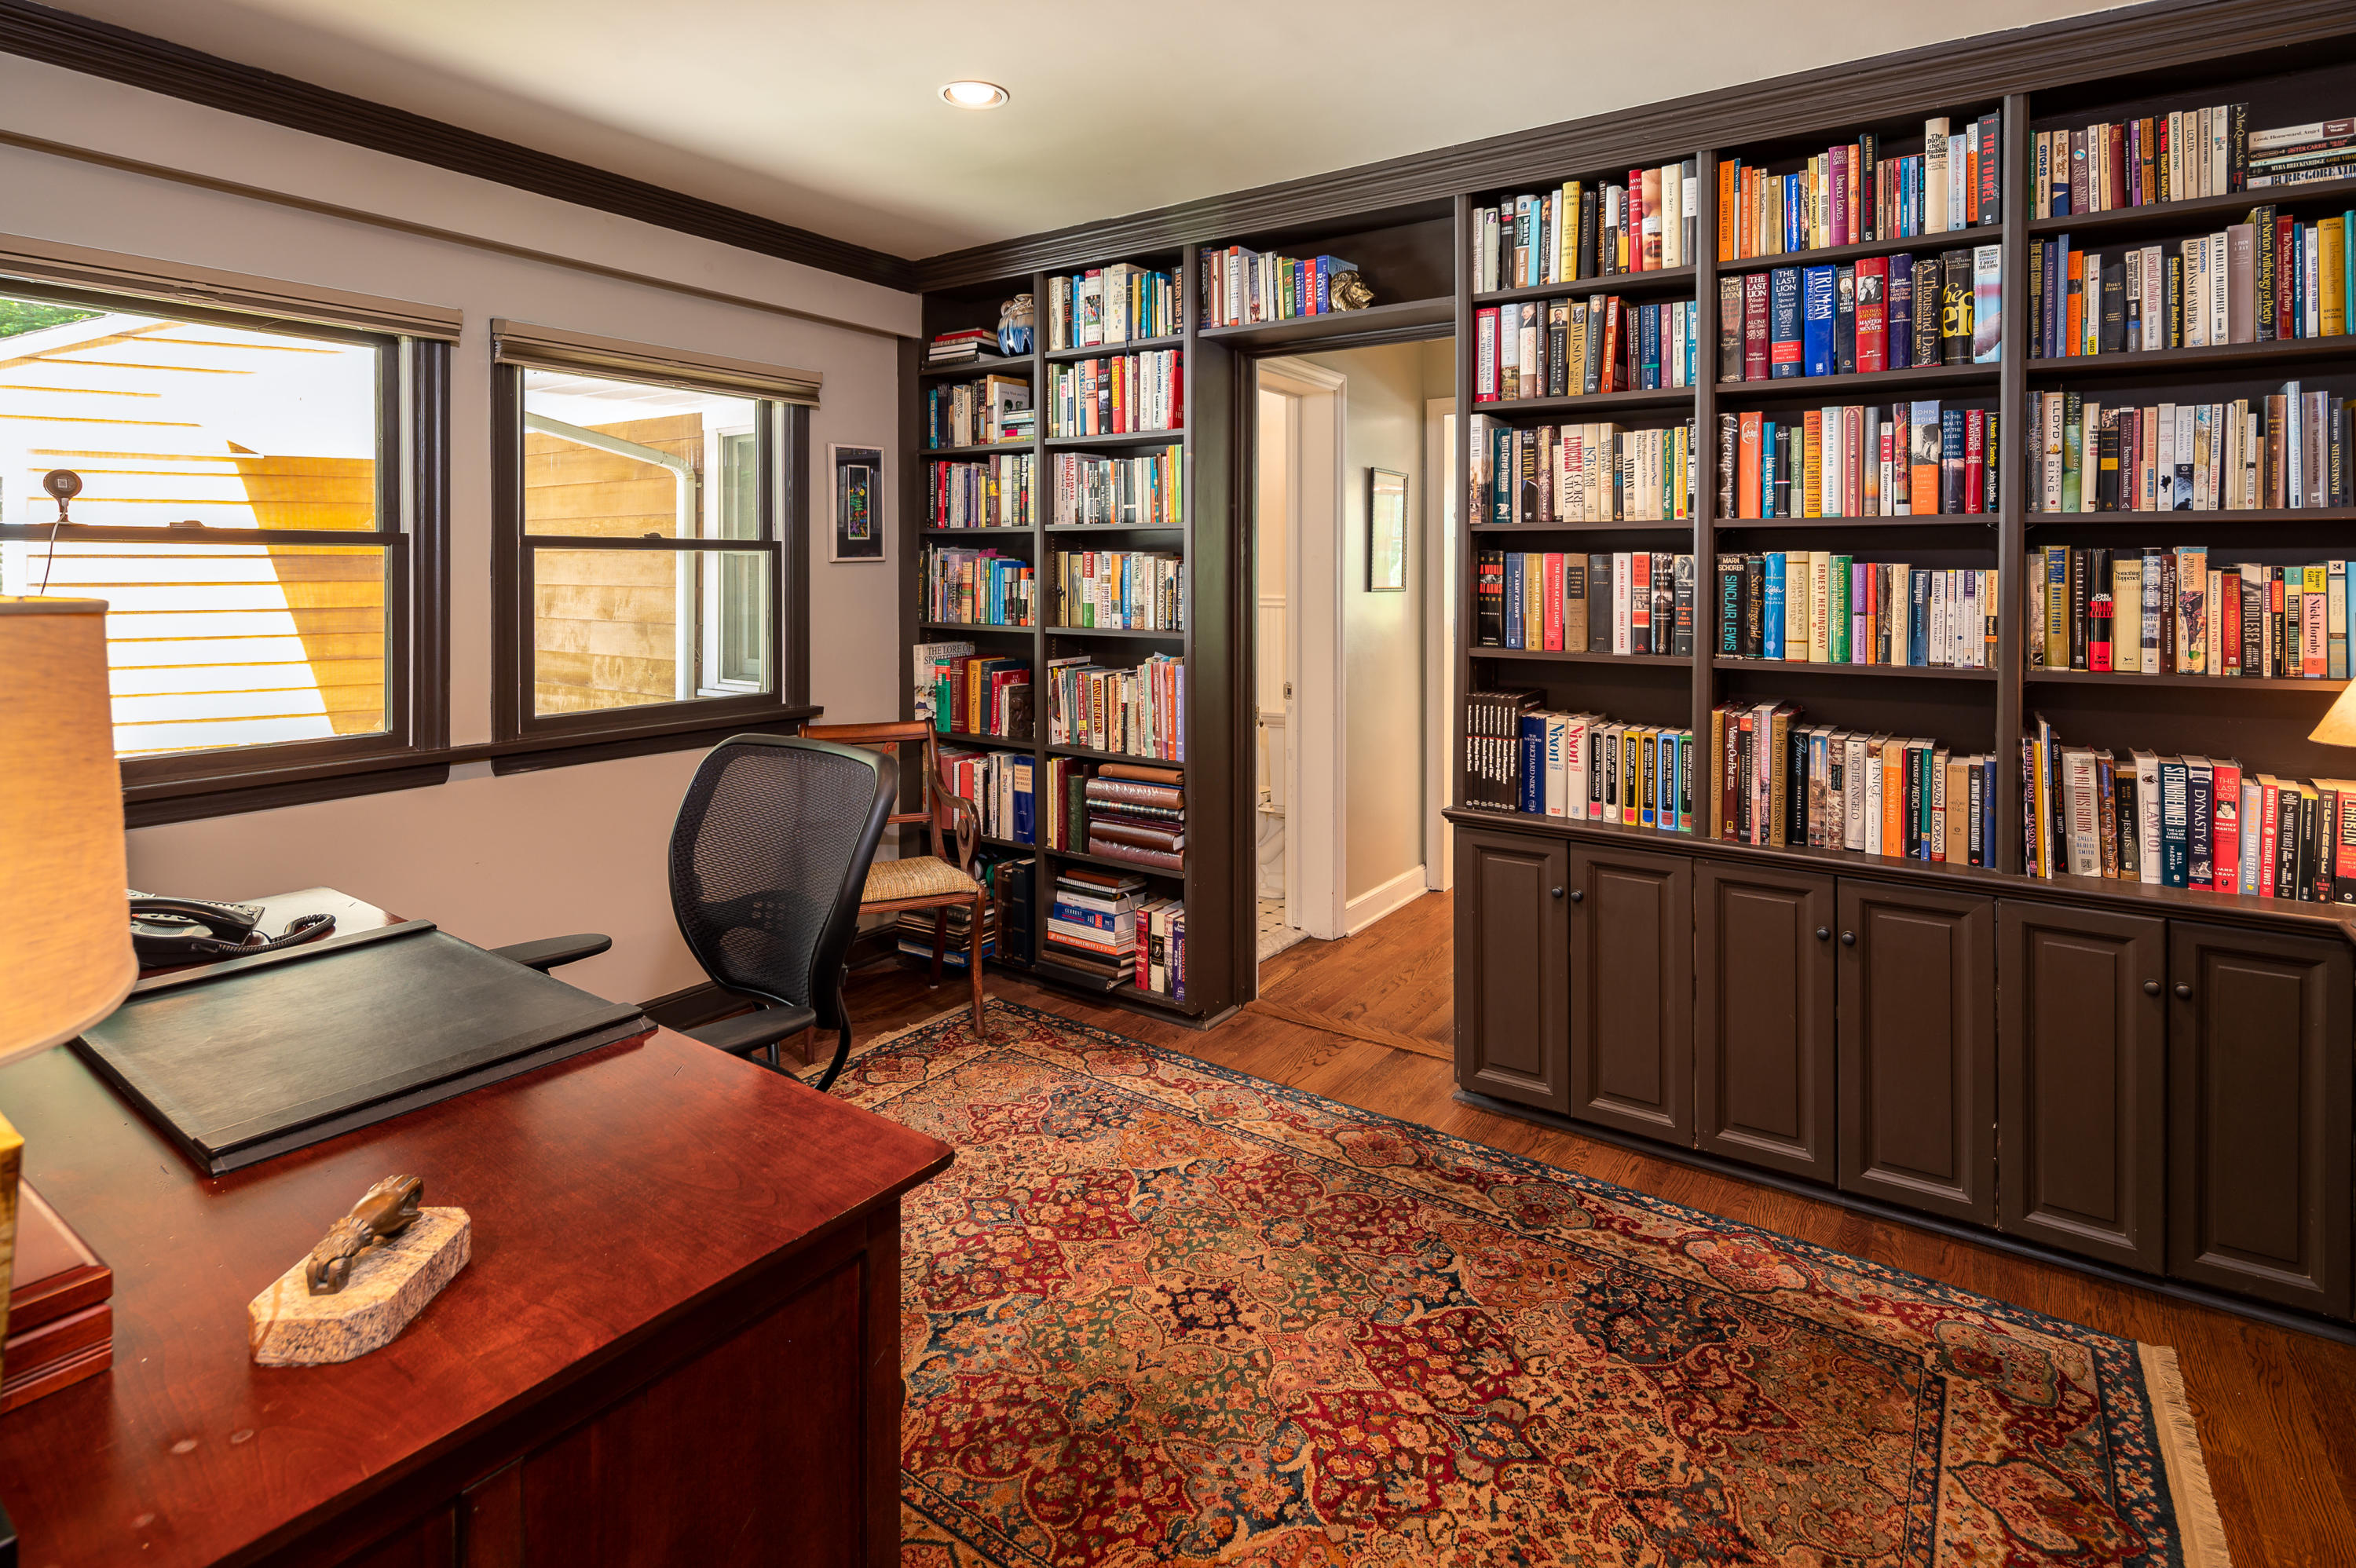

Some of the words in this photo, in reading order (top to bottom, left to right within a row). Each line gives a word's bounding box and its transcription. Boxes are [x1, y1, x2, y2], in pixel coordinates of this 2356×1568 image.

[1927, 147, 1948, 155] Bubble
[1983, 132, 1994, 156] THE
[1835, 174, 1845, 199] UNHOLY
[1982, 159, 1994, 205] TUNNEL
[1836, 200, 1845, 221] LOVES
[2262, 223, 2273, 250] Norton
[1923, 264, 1937, 274] A
[2187, 241, 2197, 285] RELIGIONS
[2258, 252, 2274, 291] Anthology
[1776, 277, 1796, 285] LAST
[1776, 284, 1796, 293] LION
[1815, 269, 1832, 320] TRUMAN
[2187, 286, 2197, 296] OF
[1923, 276, 1939, 332] Thousand
[2187, 297, 2197, 333] AMERICA
[2259, 300, 2274, 324] Poetry
[1572, 325, 1583, 364] WILSON
[1918, 335, 1935, 365] Days
[1806, 416, 1819, 446] CANADA
[2052, 400, 2061, 439] LLOYD
[1501, 435, 1509, 453] BATTLE
[1501, 453, 1509, 462] CRY
[1564, 436, 1582, 472] LINCOLN
[1722, 416, 1738, 476] Cheever
[2123, 446, 2131, 467] Benito
[1501, 469, 1510, 492] FREEDOM
[1624, 458, 1634, 489] MYRON
[1807, 455, 1819, 490] RICHARD
[2123, 468, 2131, 498] Mussolini
[2331, 444, 2340, 495] FRANKENSTEIN
[1565, 474, 1573, 508] VIDAL
[1573, 474, 1583, 508] GORE
[1807, 493, 1819, 513] FORD
[1750, 574, 1762, 597] Scott
[1817, 564, 1826, 594] ERNEST
[1724, 575, 1738, 619] SINCLAIR
[2052, 587, 2061, 609] DANIEL
[2310, 598, 2320, 619] Nick
[1749, 598, 1762, 638] Fitzgerald
[1818, 598, 1826, 650] HEMINGWAY
[2052, 612, 2061, 634] YERGIN
[2244, 596, 2260, 643] MIDDLESEX
[927, 647, 943, 655] THE
[943, 645, 960, 654] LORE
[962, 644, 973, 653] OF
[1724, 622, 1737, 651] LEWIS
[2308, 622, 2320, 656] Hornby
[1093, 680, 1101, 705] MASTER
[1094, 707, 1102, 733] RECIPES
[1775, 728, 1784, 739] The
[1549, 722, 1565, 762] Nixon
[1569, 724, 1584, 764] Nixon
[1727, 726, 1737, 749] Visiting
[1728, 749, 1737, 762] Our
[1728, 762, 1737, 775] Past
[1775, 740, 1784, 777] Panorama
[2026, 746, 2034, 775] ROBERT
[1872, 759, 1881, 797] VENICE
[1934, 762, 1942, 779] LUIGI
[1775, 783, 1784, 793] the
[1851, 751, 1860, 820] MICHELANGELO
[1934, 780, 1942, 806] BARZINI
[2027, 779, 2035, 804] FROST
[2164, 766, 2187, 827] STEINBRENNER
[2217, 791, 2235, 800] BOY
[1774, 794, 1784, 838] Renaissance
[2194, 789, 2206, 842] DYNASTY
[2266, 788, 2275, 824] MONEYBALL
[1933, 812, 1942, 852] EUROPEANS
[2246, 834, 2256, 856] FRANK
[2245, 857, 2256, 884] DEFORD
[2263, 866, 2271, 885] LEWIS
[1056, 934, 1069, 943] HOME
[1068, 937, 1096, 948] IMPROVEMENT
